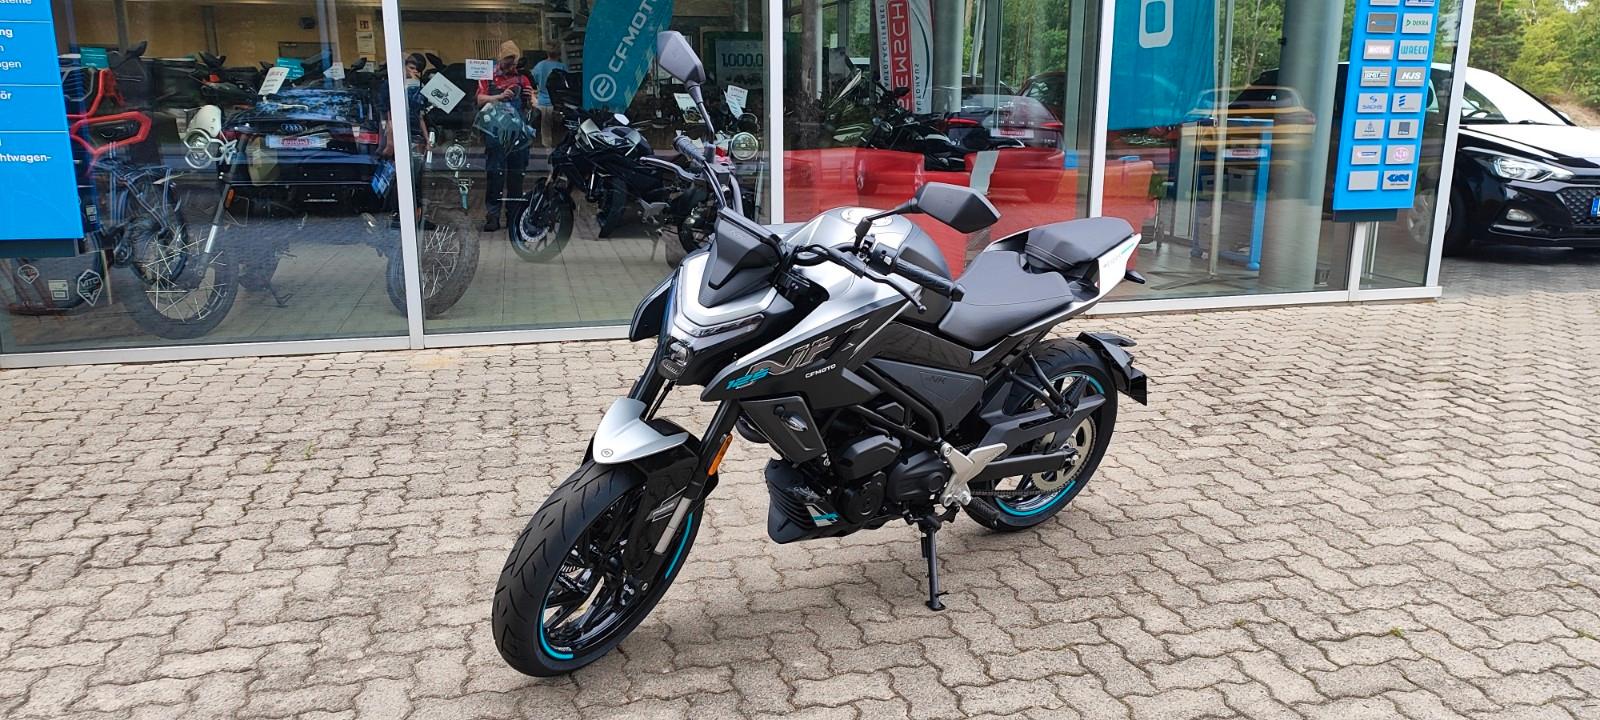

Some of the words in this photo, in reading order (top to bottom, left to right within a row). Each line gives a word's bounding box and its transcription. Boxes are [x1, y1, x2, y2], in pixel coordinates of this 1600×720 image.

[1400, 45, 1428, 55] WAECO
[0, 60, 22, 70] gen
[1401, 71, 1421, 80] HJS
[805, 363, 837, 379] CFMOTO
[726, 367, 770, 390] 125
